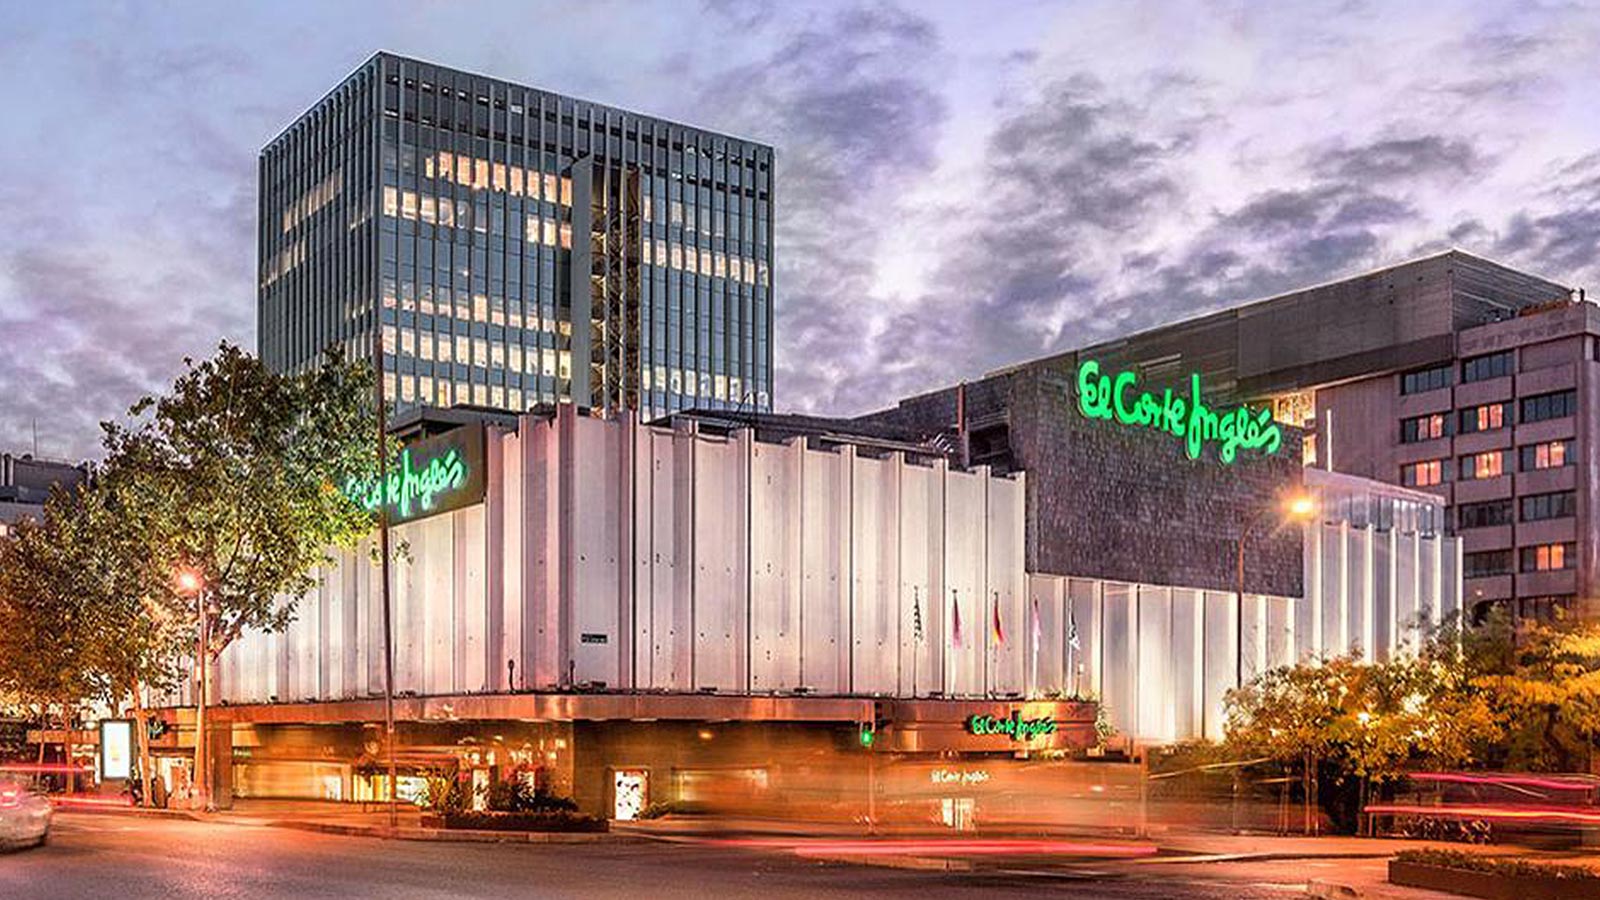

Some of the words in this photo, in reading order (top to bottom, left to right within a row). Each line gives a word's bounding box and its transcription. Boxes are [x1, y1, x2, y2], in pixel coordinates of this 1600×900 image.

[1079, 361, 1112, 419] El
[1114, 371, 1185, 436] Corte
[1188, 373, 1280, 463] Inglés
[401, 449, 463, 517] Inglés
[972, 715, 985, 735] El
